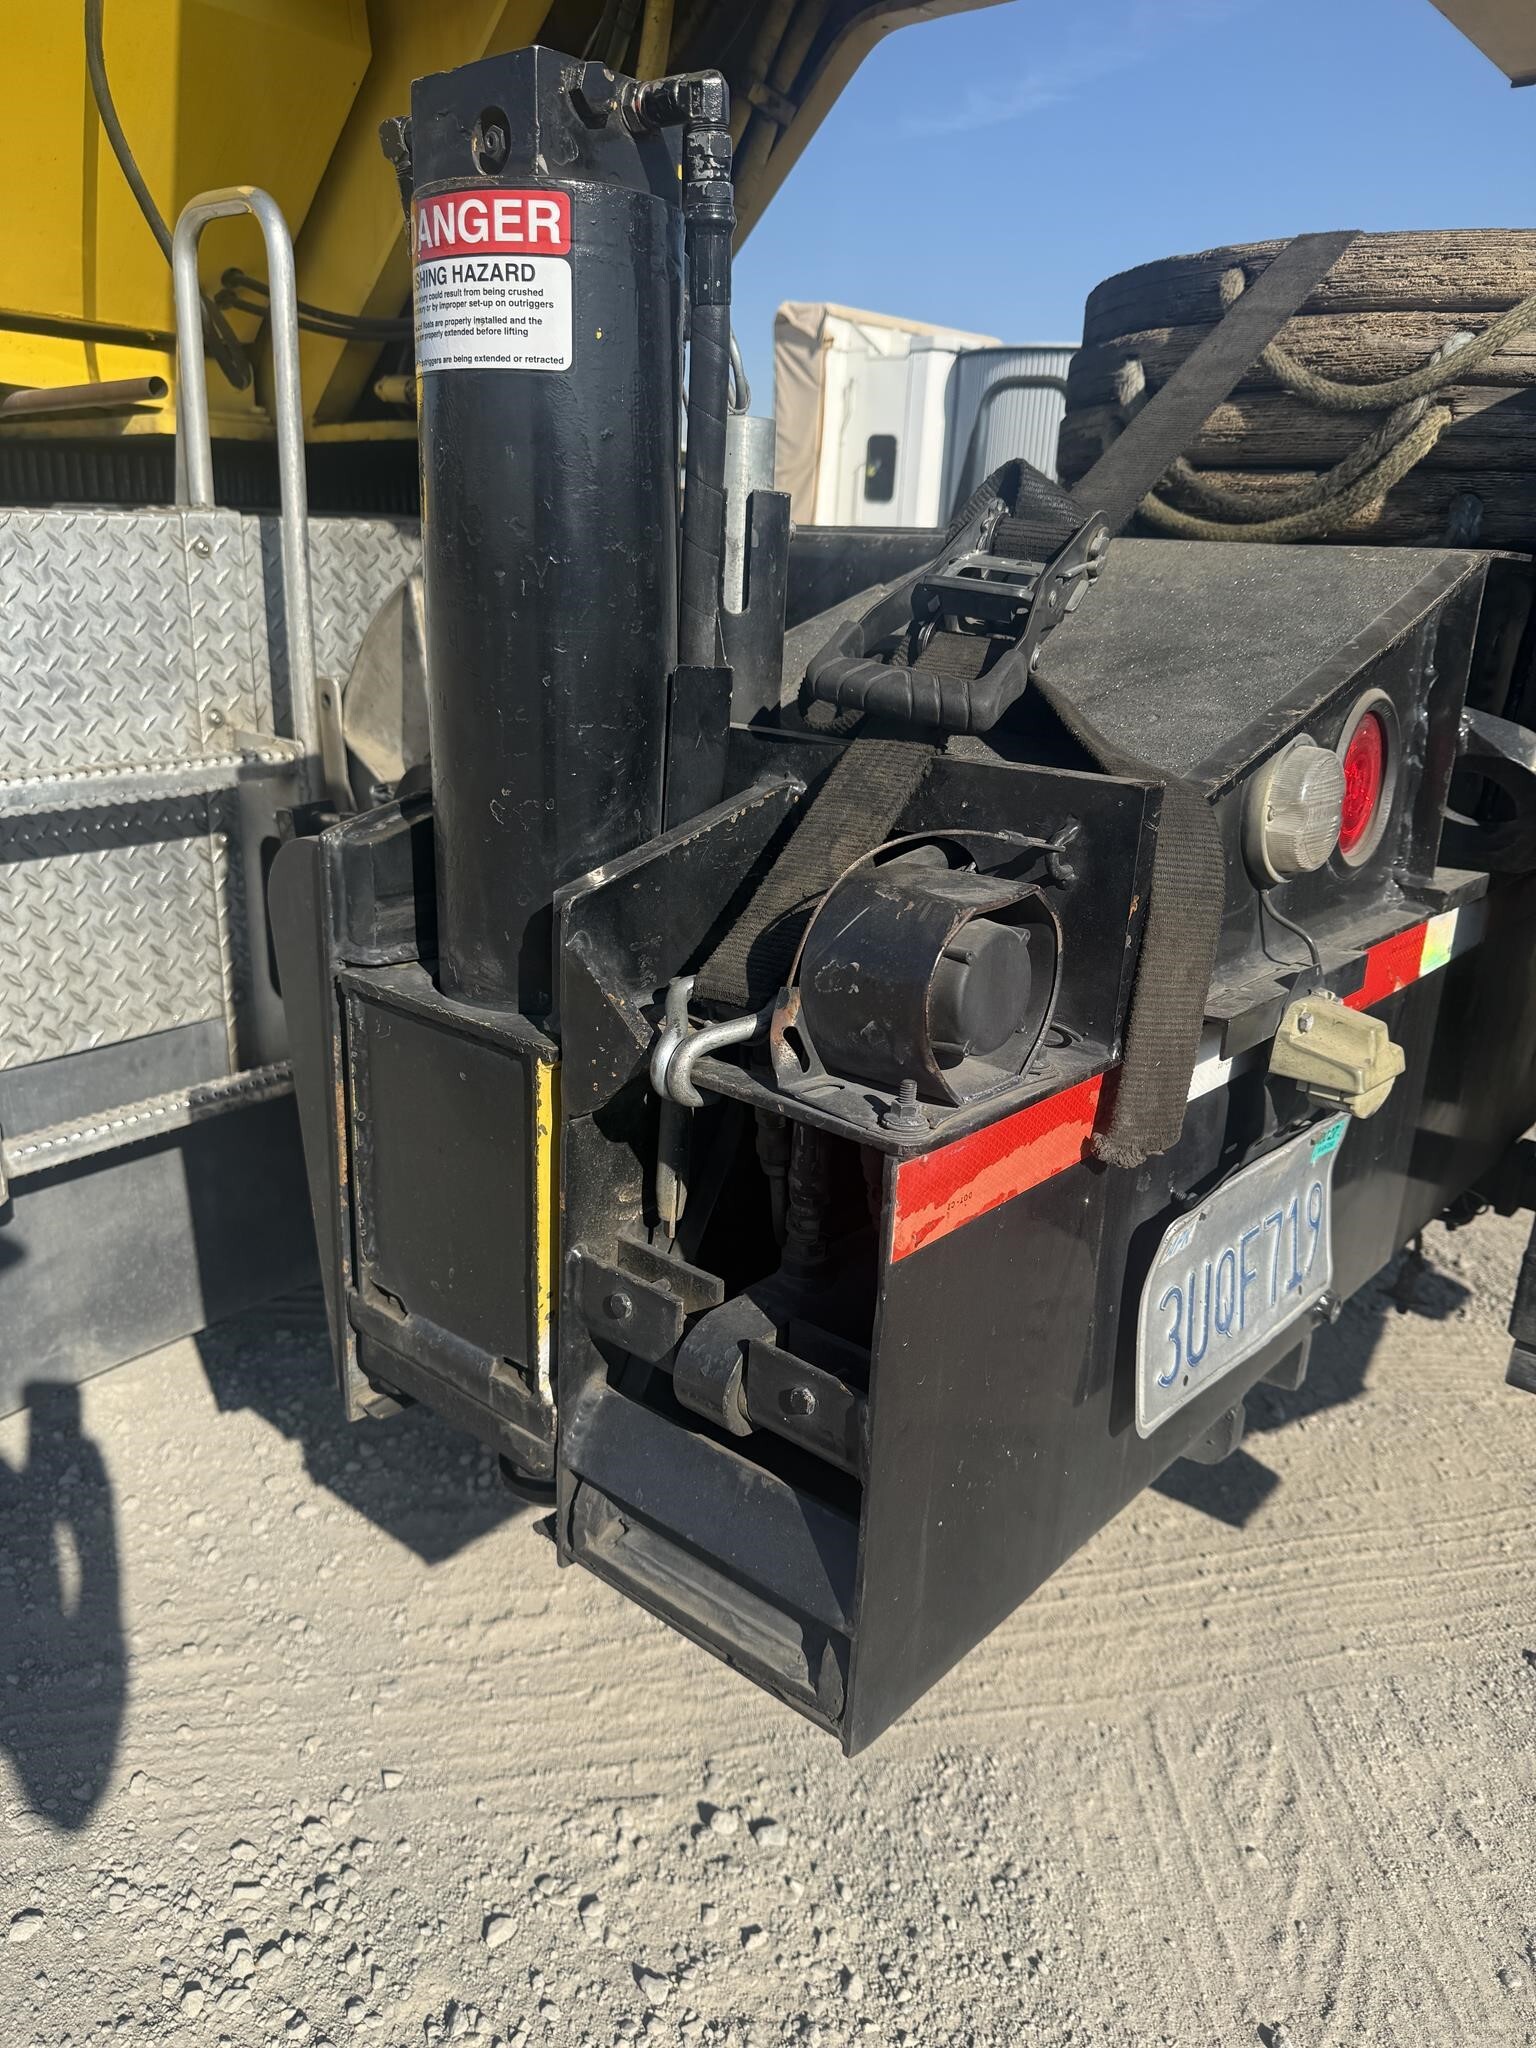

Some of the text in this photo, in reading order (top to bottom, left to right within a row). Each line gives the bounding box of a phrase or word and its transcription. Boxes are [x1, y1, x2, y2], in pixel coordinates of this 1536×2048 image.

[452, 263, 536, 283] HAZARD
[429, 290, 443, 300] could
[444, 288, 462, 298] result
[463, 288, 481, 296] from
[482, 287, 506, 297] being
[508, 287, 544, 297] crushed
[431, 303, 438, 312] by
[439, 300, 467, 311] improper
[468, 299, 493, 308] set-up
[508, 299, 554, 310] outriggers
[444, 316, 472, 328] properly
[473, 316, 508, 325] installed
[510, 316, 526, 325] and
[528, 316, 543, 325] the
[424, 330, 444, 339] properly
[444, 328, 474, 337] extended
[476, 327, 502, 336] before
[504, 327, 529, 338] lifting
[443, 356, 452, 364] are
[453, 355, 473, 364] being
[474, 354, 511, 363] extended
[513, 355, 522, 363] or
[525, 355, 564, 365] retracted
[1158, 1182, 1323, 1389] 3UQF719
